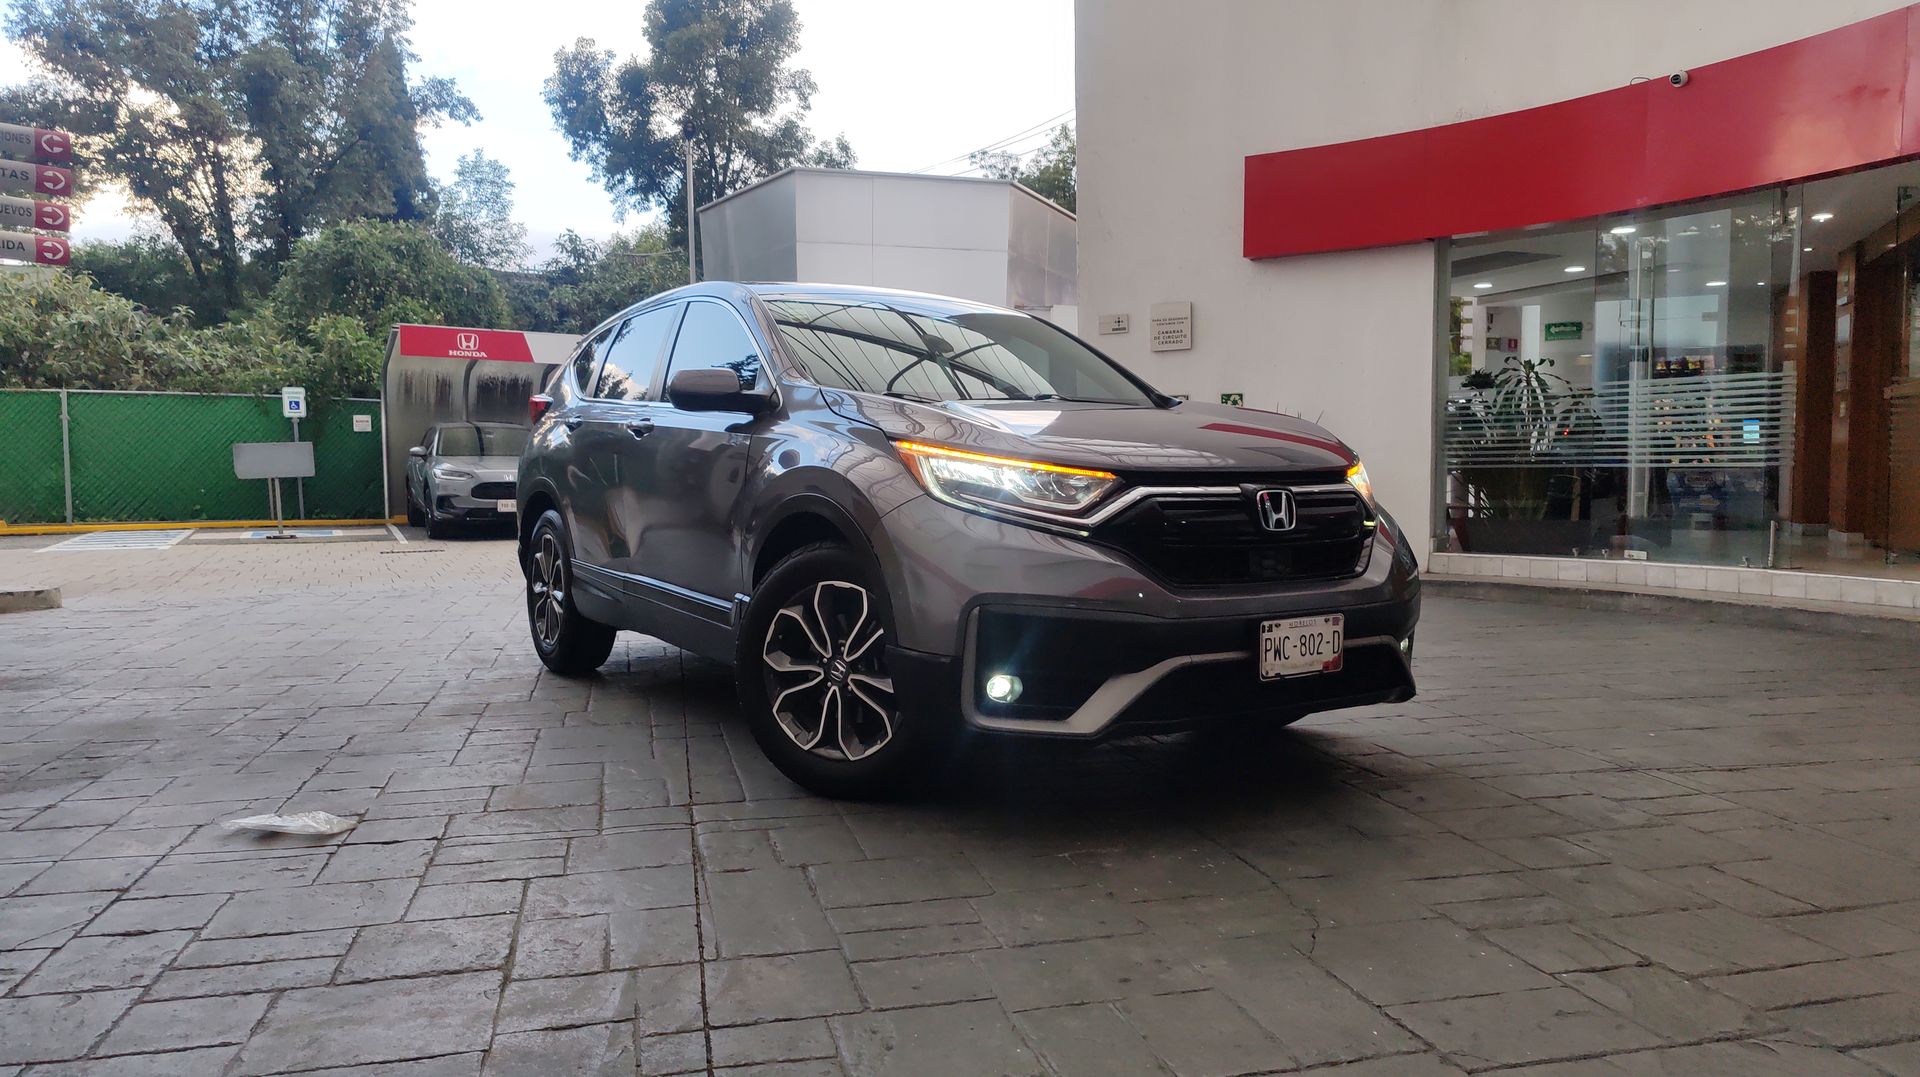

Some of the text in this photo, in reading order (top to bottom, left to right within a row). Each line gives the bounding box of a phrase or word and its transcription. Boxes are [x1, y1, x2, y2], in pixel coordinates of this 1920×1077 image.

[0, 168, 29, 181] TAS
[0, 240, 26, 251] IDA
[448, 350, 488, 358] HONDA
[1263, 630, 1341, 663] PWC-802-D
